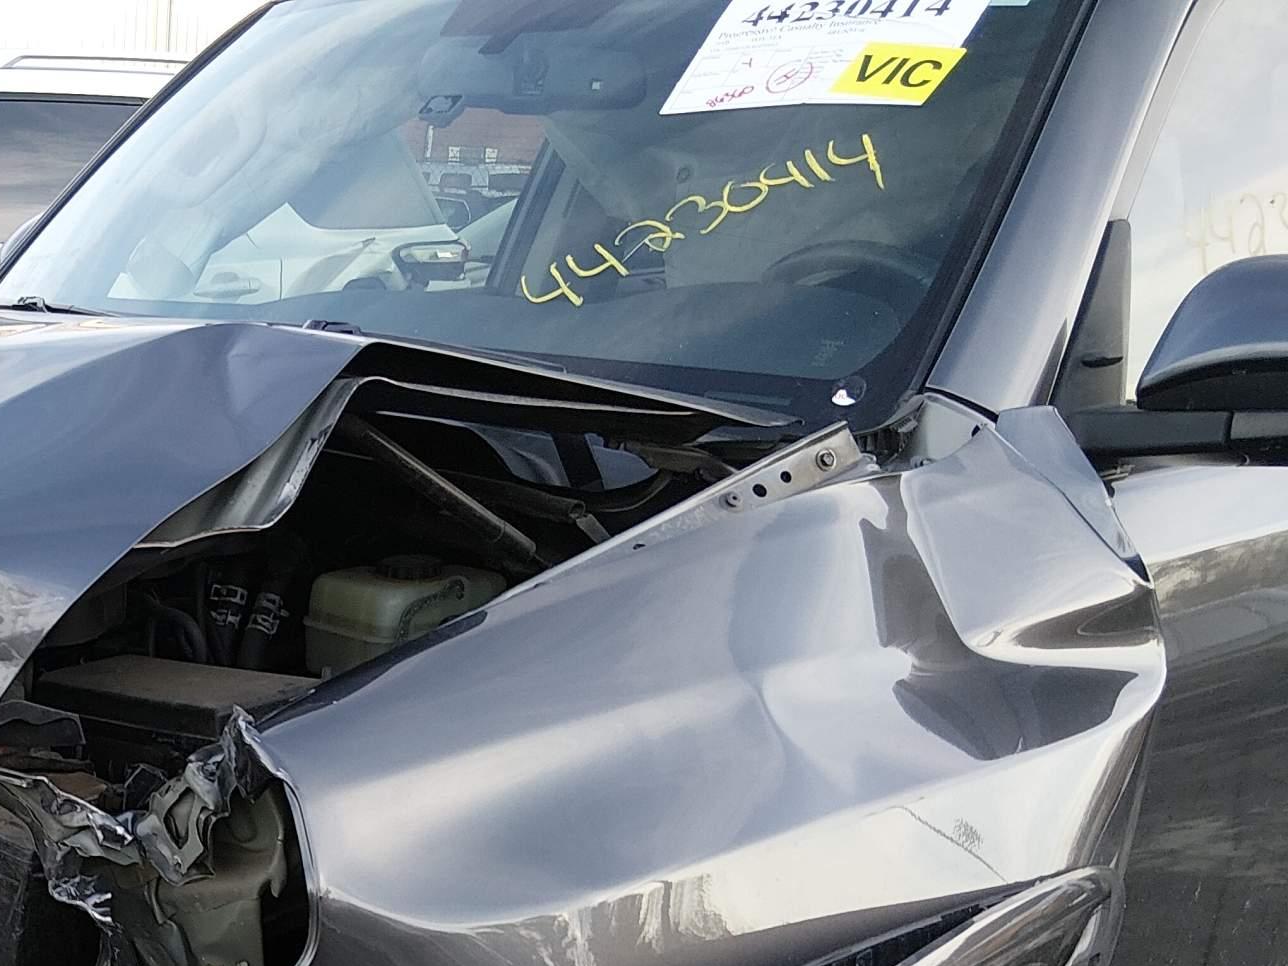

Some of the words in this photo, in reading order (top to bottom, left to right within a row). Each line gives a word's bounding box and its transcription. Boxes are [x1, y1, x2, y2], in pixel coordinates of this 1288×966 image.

[741, 0, 952, 27] 44230414
[854, 53, 943, 89] VIC
[521, 133, 885, 307] 44230414
